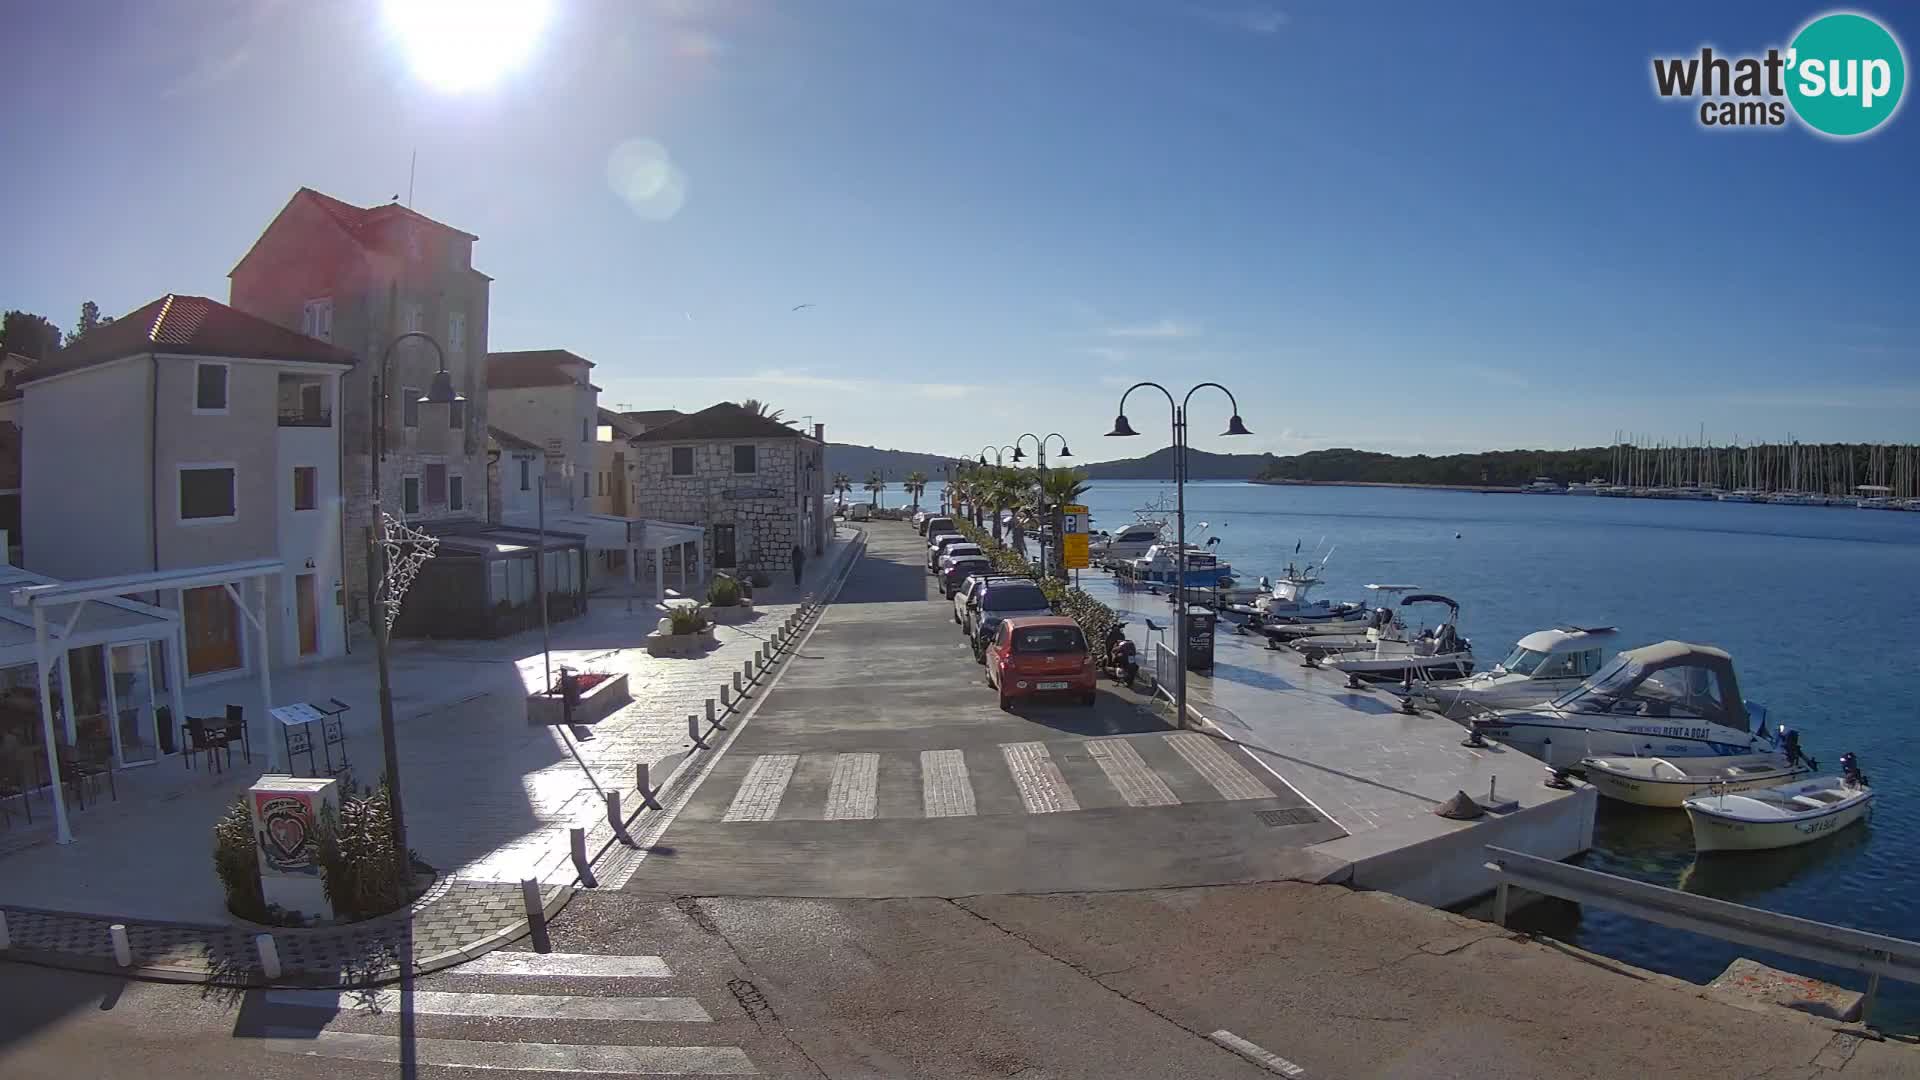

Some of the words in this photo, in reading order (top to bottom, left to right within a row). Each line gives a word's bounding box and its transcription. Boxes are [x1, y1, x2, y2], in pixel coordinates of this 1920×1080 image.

[1663, 726, 1683, 737] RENT
[1684, 727, 1689, 737] A
[1691, 727, 1711, 740] BOAT
